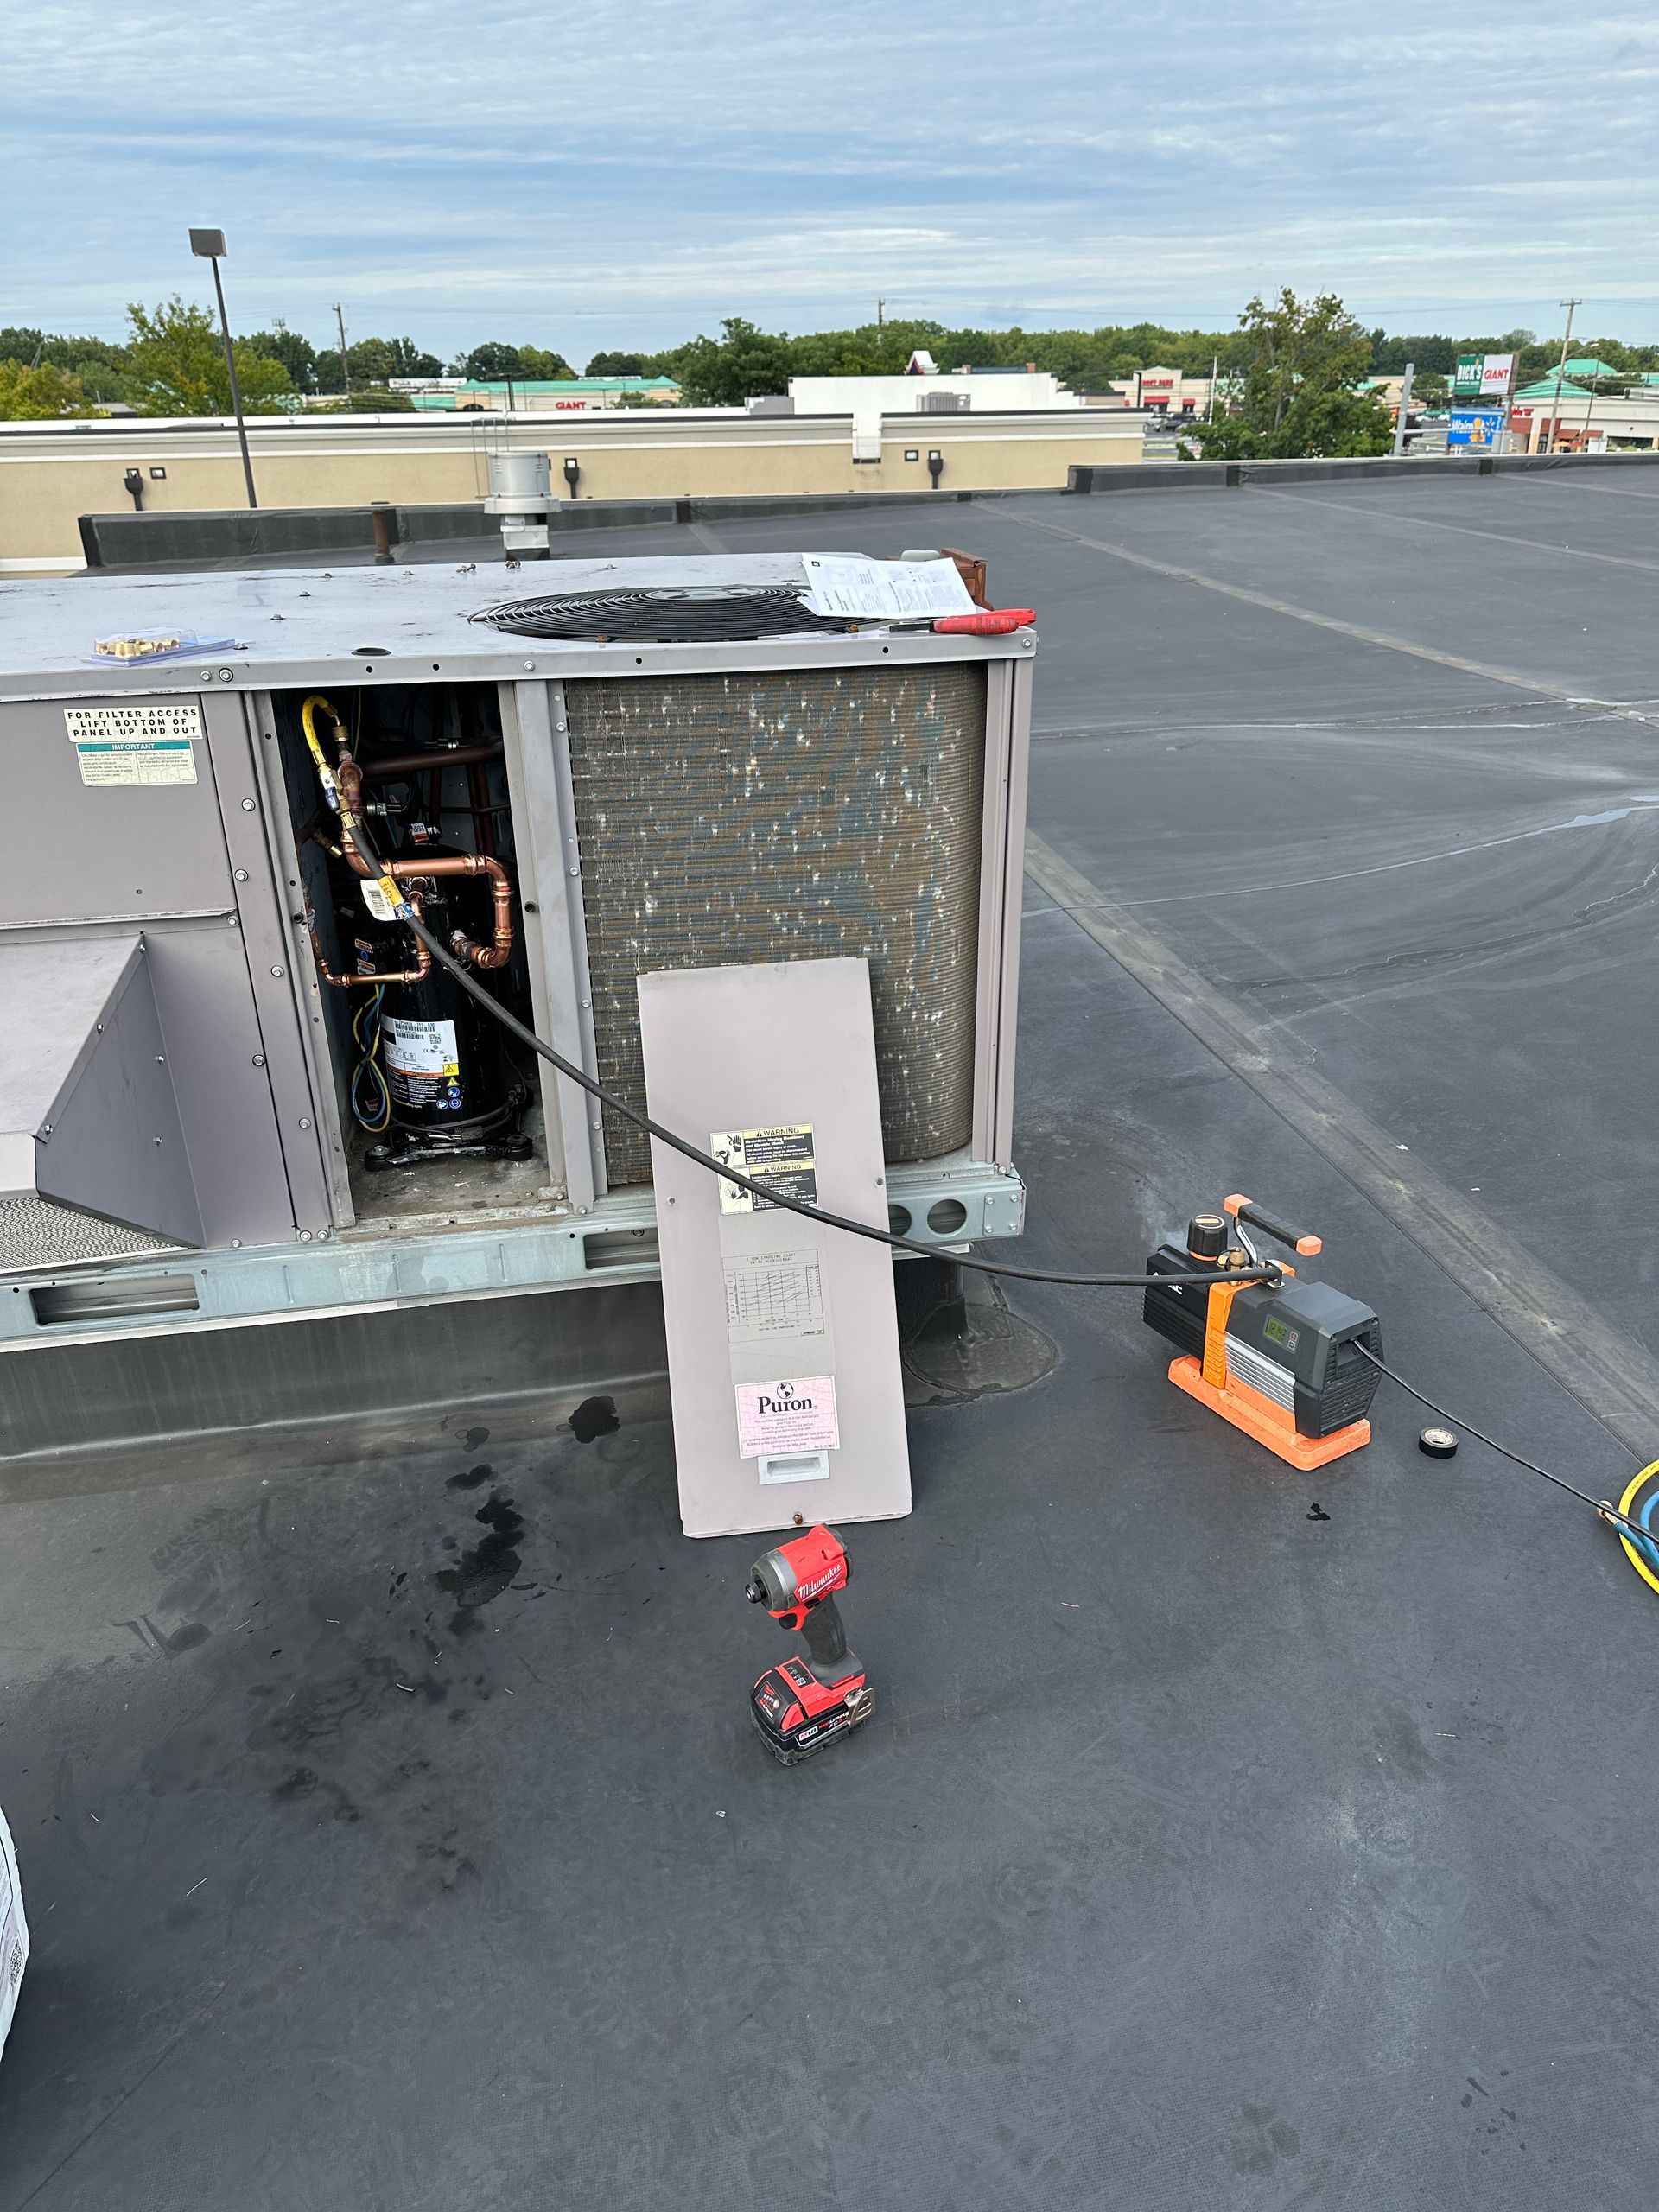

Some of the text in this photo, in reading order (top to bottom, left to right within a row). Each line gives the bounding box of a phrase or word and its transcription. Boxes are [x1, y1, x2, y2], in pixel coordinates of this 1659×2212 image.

[1457, 365, 1483, 380] DICK'S
[1484, 370, 1509, 379] GIANT
[556, 401, 586, 410] GIANT
[763, 1127, 799, 1136] WARNING
[770, 1164, 802, 1173] WARNING
[757, 1395, 814, 1414] Puron
[798, 1564, 842, 1599] Milwaukee
[800, 1727, 817, 1740] M18
